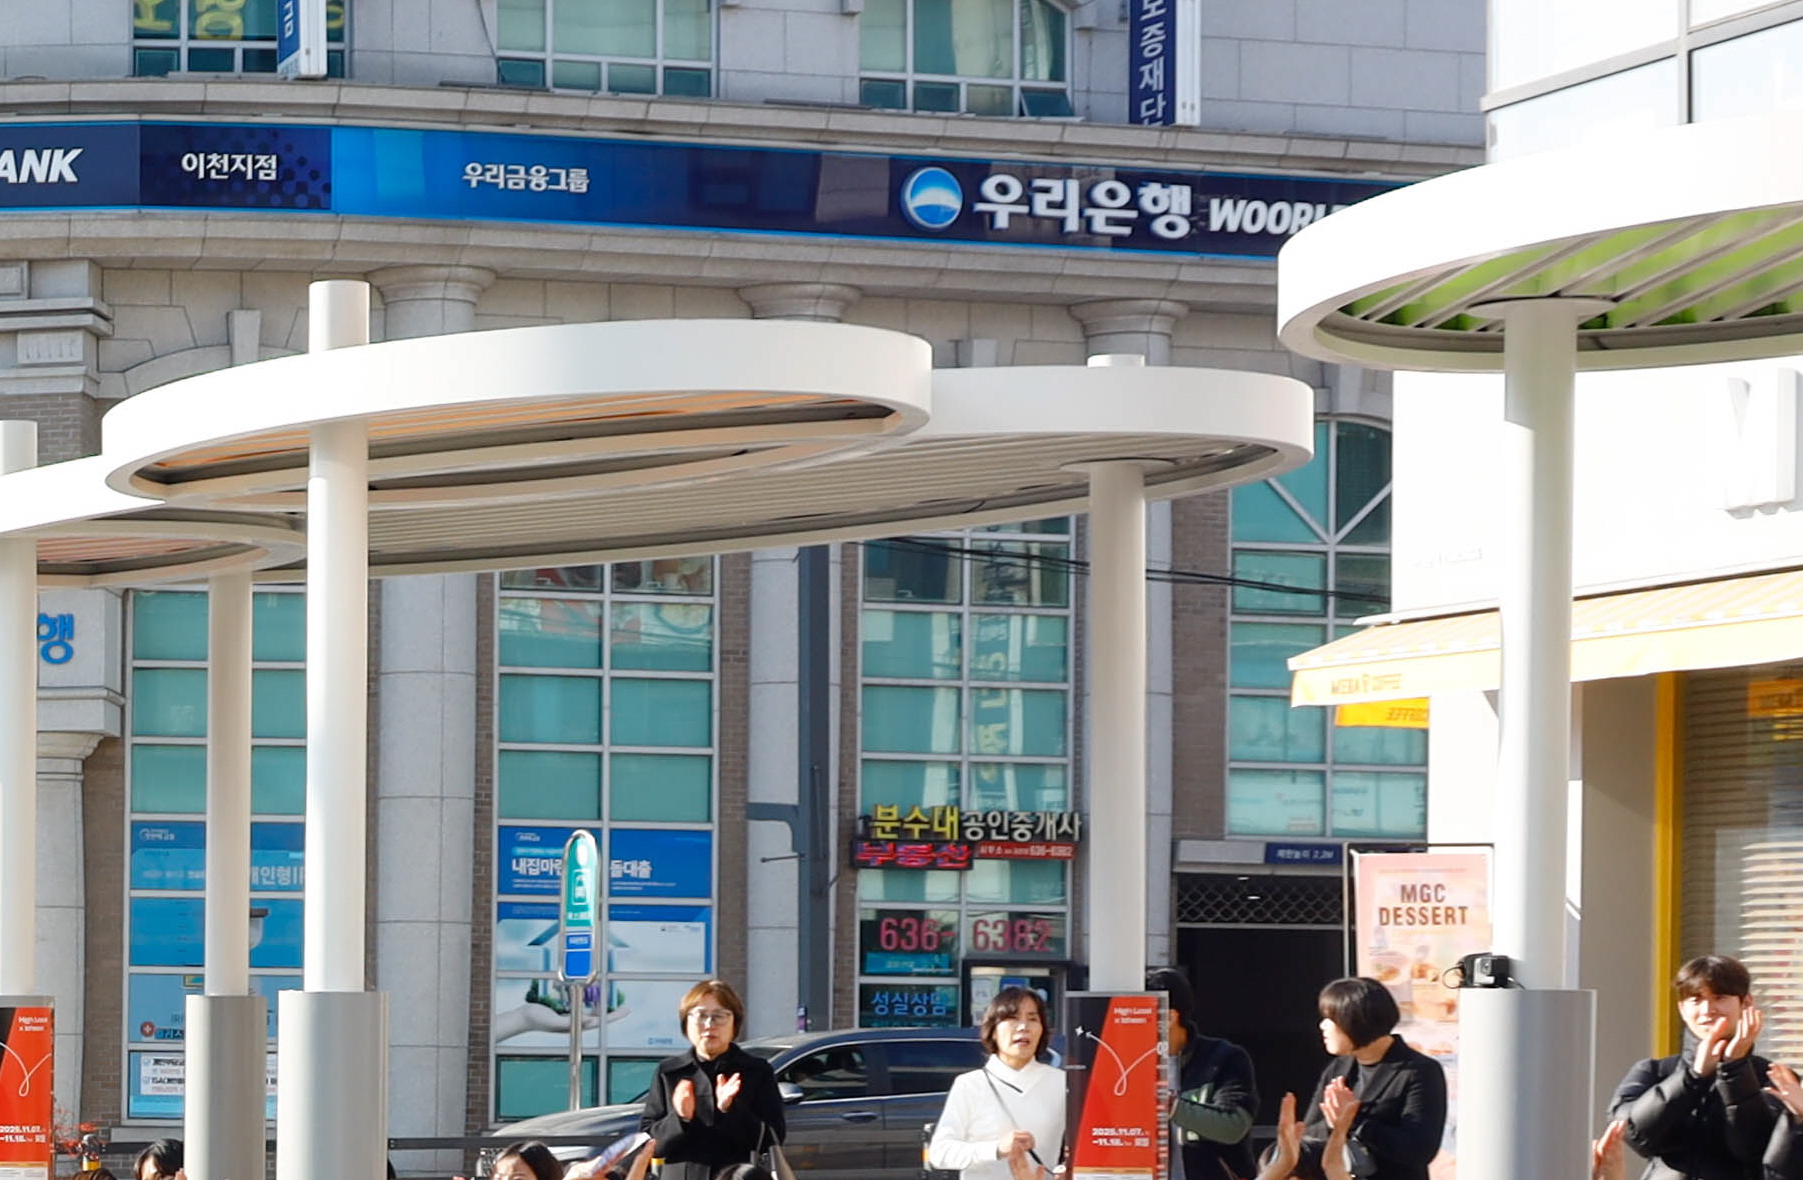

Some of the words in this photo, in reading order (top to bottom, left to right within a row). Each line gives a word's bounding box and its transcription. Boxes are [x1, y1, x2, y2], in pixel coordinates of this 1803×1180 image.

[181, 152, 278, 181] 이천지점
[462, 162, 590, 194] 우리금융그룹
[973, 172, 1193, 241] 우리은행
[870, 804, 960, 840] 분수대
[962, 810, 1083, 842] 공인중개사
[855, 842, 973, 867] 부동산
[1400, 883, 1447, 902] MGC
[1379, 905, 1469, 926] DESSERT
[972, 918, 1051, 953] 6382
